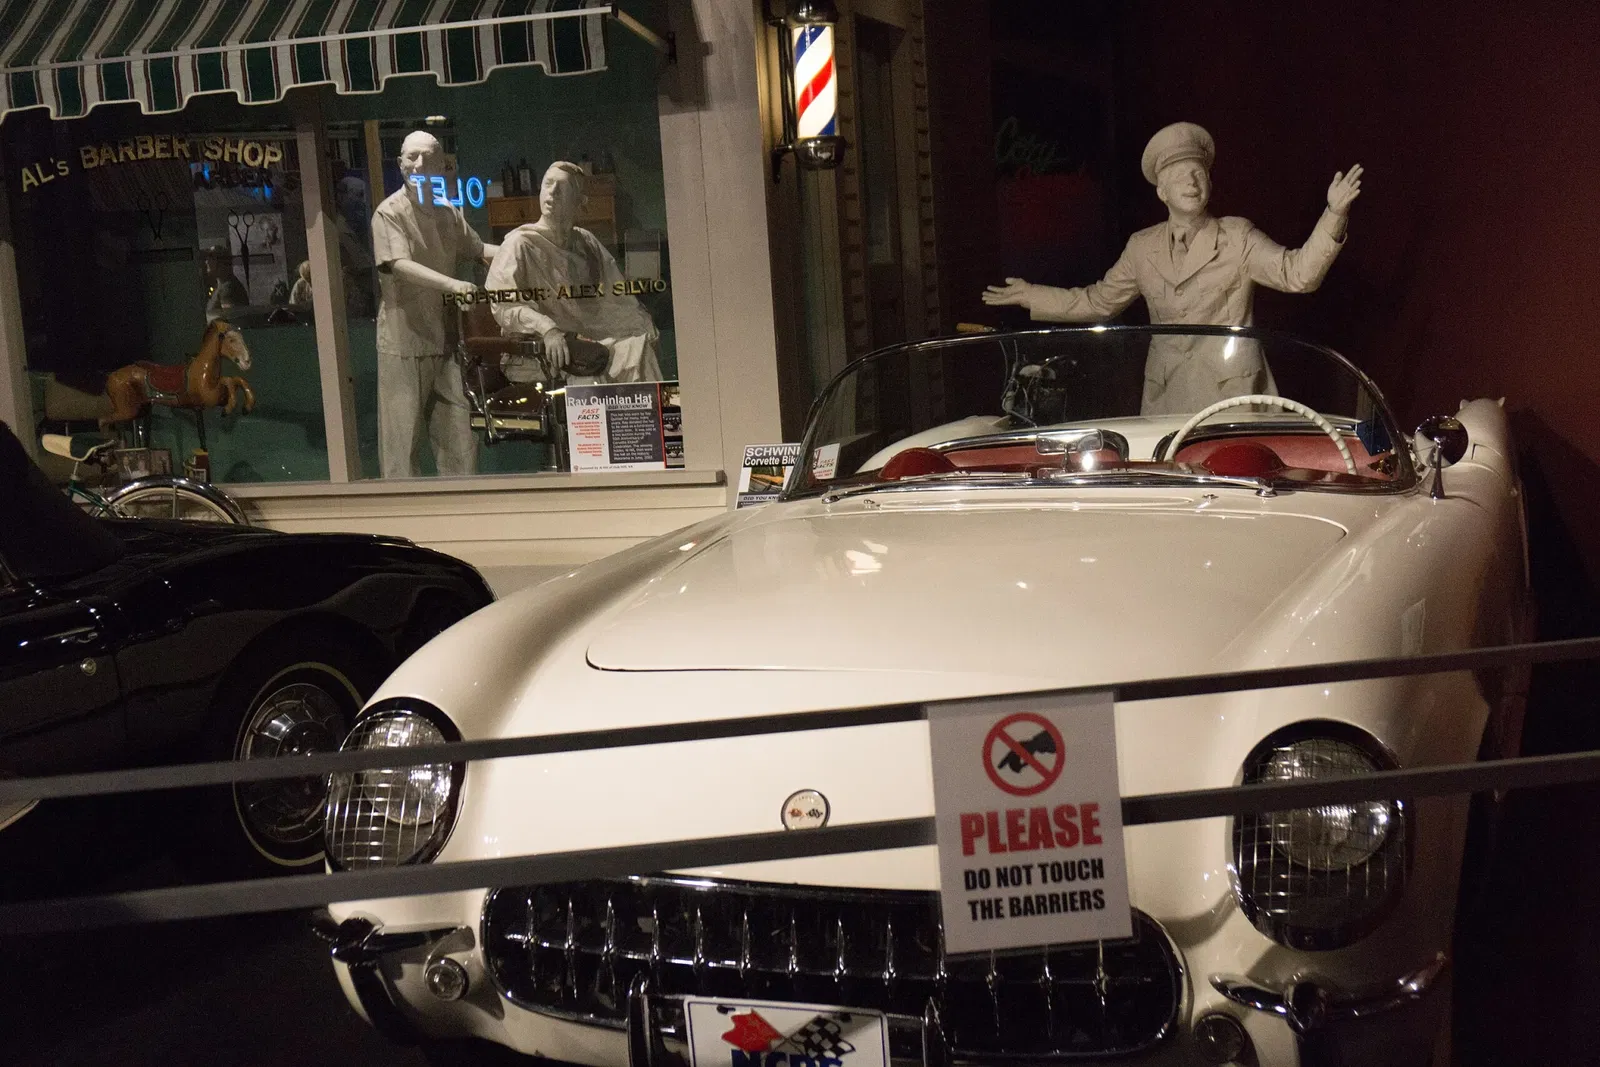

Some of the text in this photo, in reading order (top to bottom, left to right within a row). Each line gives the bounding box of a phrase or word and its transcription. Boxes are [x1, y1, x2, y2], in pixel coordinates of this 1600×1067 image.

[20, 134, 284, 193] AL's BARBER SHOP
[442, 279, 668, 306] PROPRIETOR: ALEX SILVIO
[567, 393, 653, 407] Ray Quinlan Hat
[744, 456, 780, 466] Corvette
[959, 801, 1103, 857] PLEASE
[963, 858, 1105, 891] DO NOT TOUCH
[967, 889, 1106, 921] THE BARRIERS
